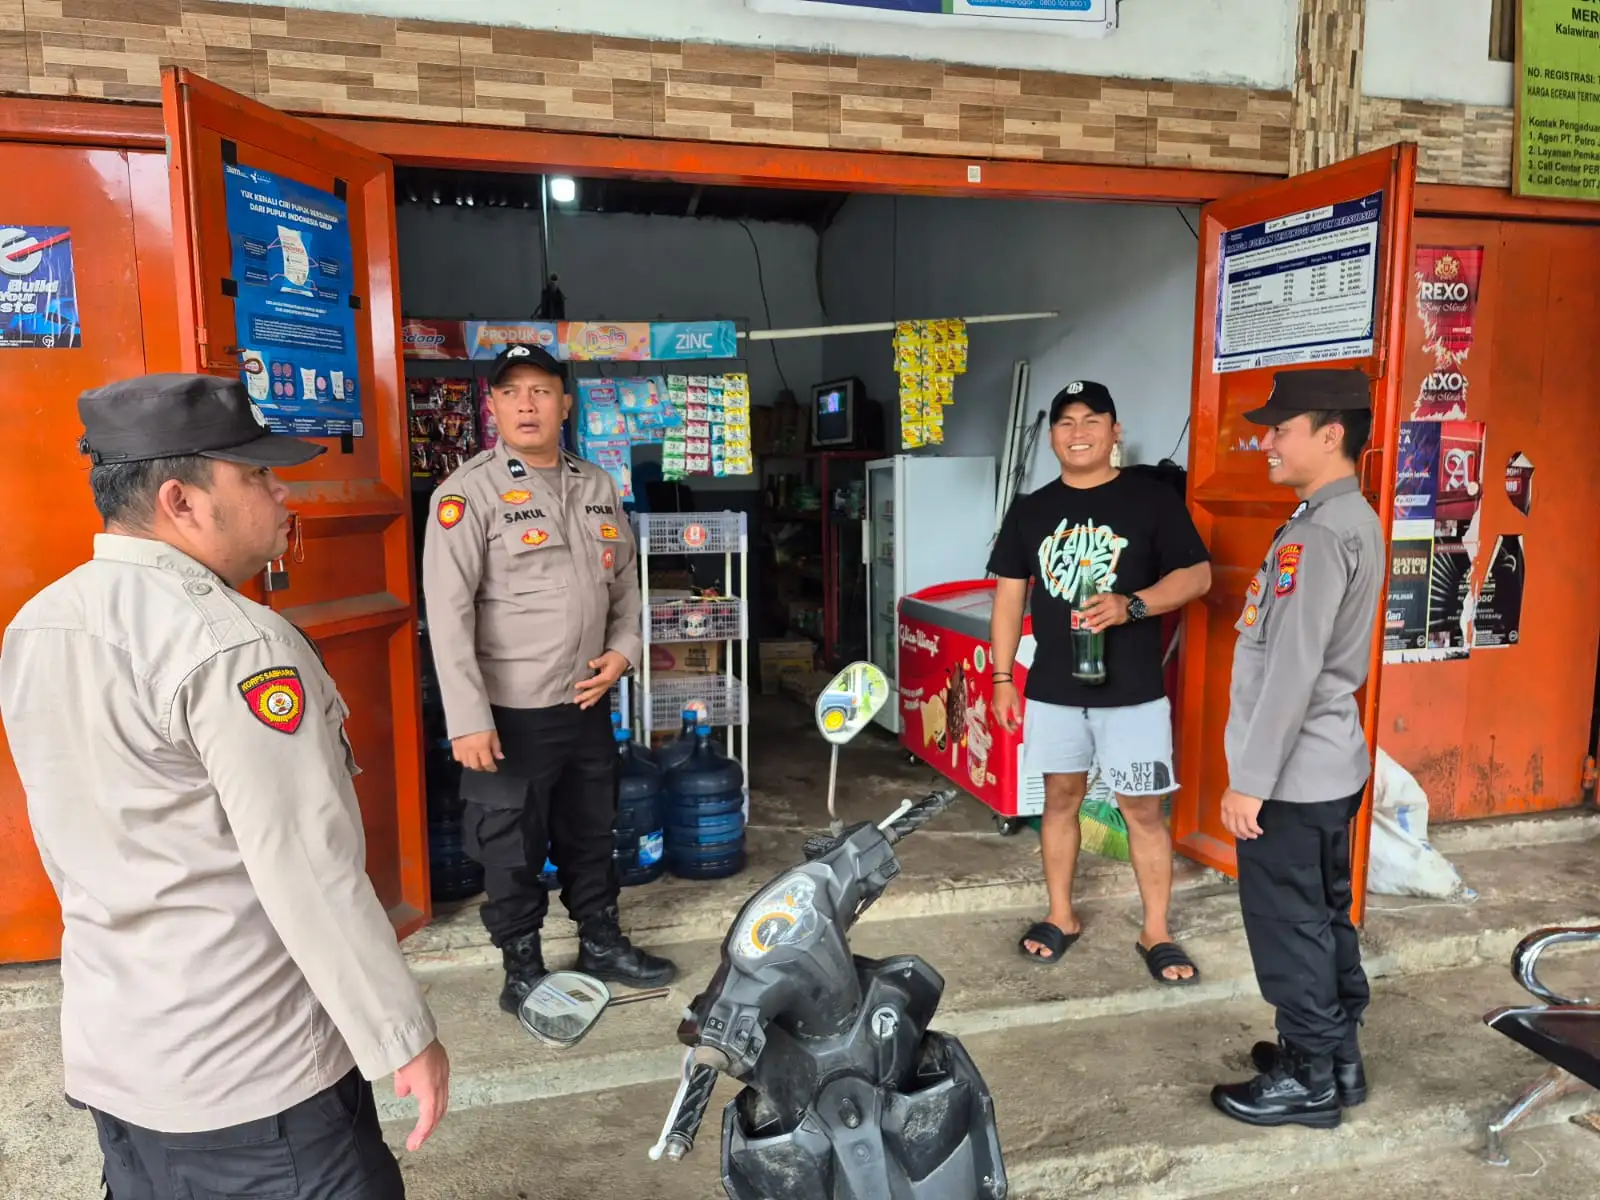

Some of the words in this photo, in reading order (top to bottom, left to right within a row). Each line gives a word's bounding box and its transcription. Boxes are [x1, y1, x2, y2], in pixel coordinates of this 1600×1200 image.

[1572, 7, 1600, 24] MER
[1527, 67, 1542, 78] NO.
[1545, 69, 1596, 84] REGISTRASI:
[1551, 88, 1576, 99] ECERAN
[1528, 116, 1557, 128] Kontak
[1538, 132, 1559, 145] Agen
[1561, 134, 1573, 144] PT.
[1575, 135, 1596, 147] Petro
[1528, 146, 1536, 155] 2.
[1538, 146, 1572, 158] Layanan
[1537, 160, 1553, 171] Call
[1554, 162, 1581, 173] Center
[1528, 174, 1535, 184] 4.
[1537, 174, 1553, 185] Call
[1554, 176, 1581, 187] Center
[254, 193, 278, 206] KENALI
[249, 203, 265, 213] DARI
[266, 207, 287, 219] PUPUK
[8, 280, 58, 292] Build
[1421, 282, 1469, 301] REXO
[480, 328, 536, 342] PRODUK
[676, 333, 713, 350] ZINC
[503, 508, 546, 524] SAKUL
[1393, 565, 1427, 575] GOLD
[241, 674, 265, 692] KORPS
[1131, 762, 1152, 773] SIT
[1109, 767, 1127, 781] ON
[1133, 772, 1152, 783] MY
[1115, 780, 1153, 792] FACE
